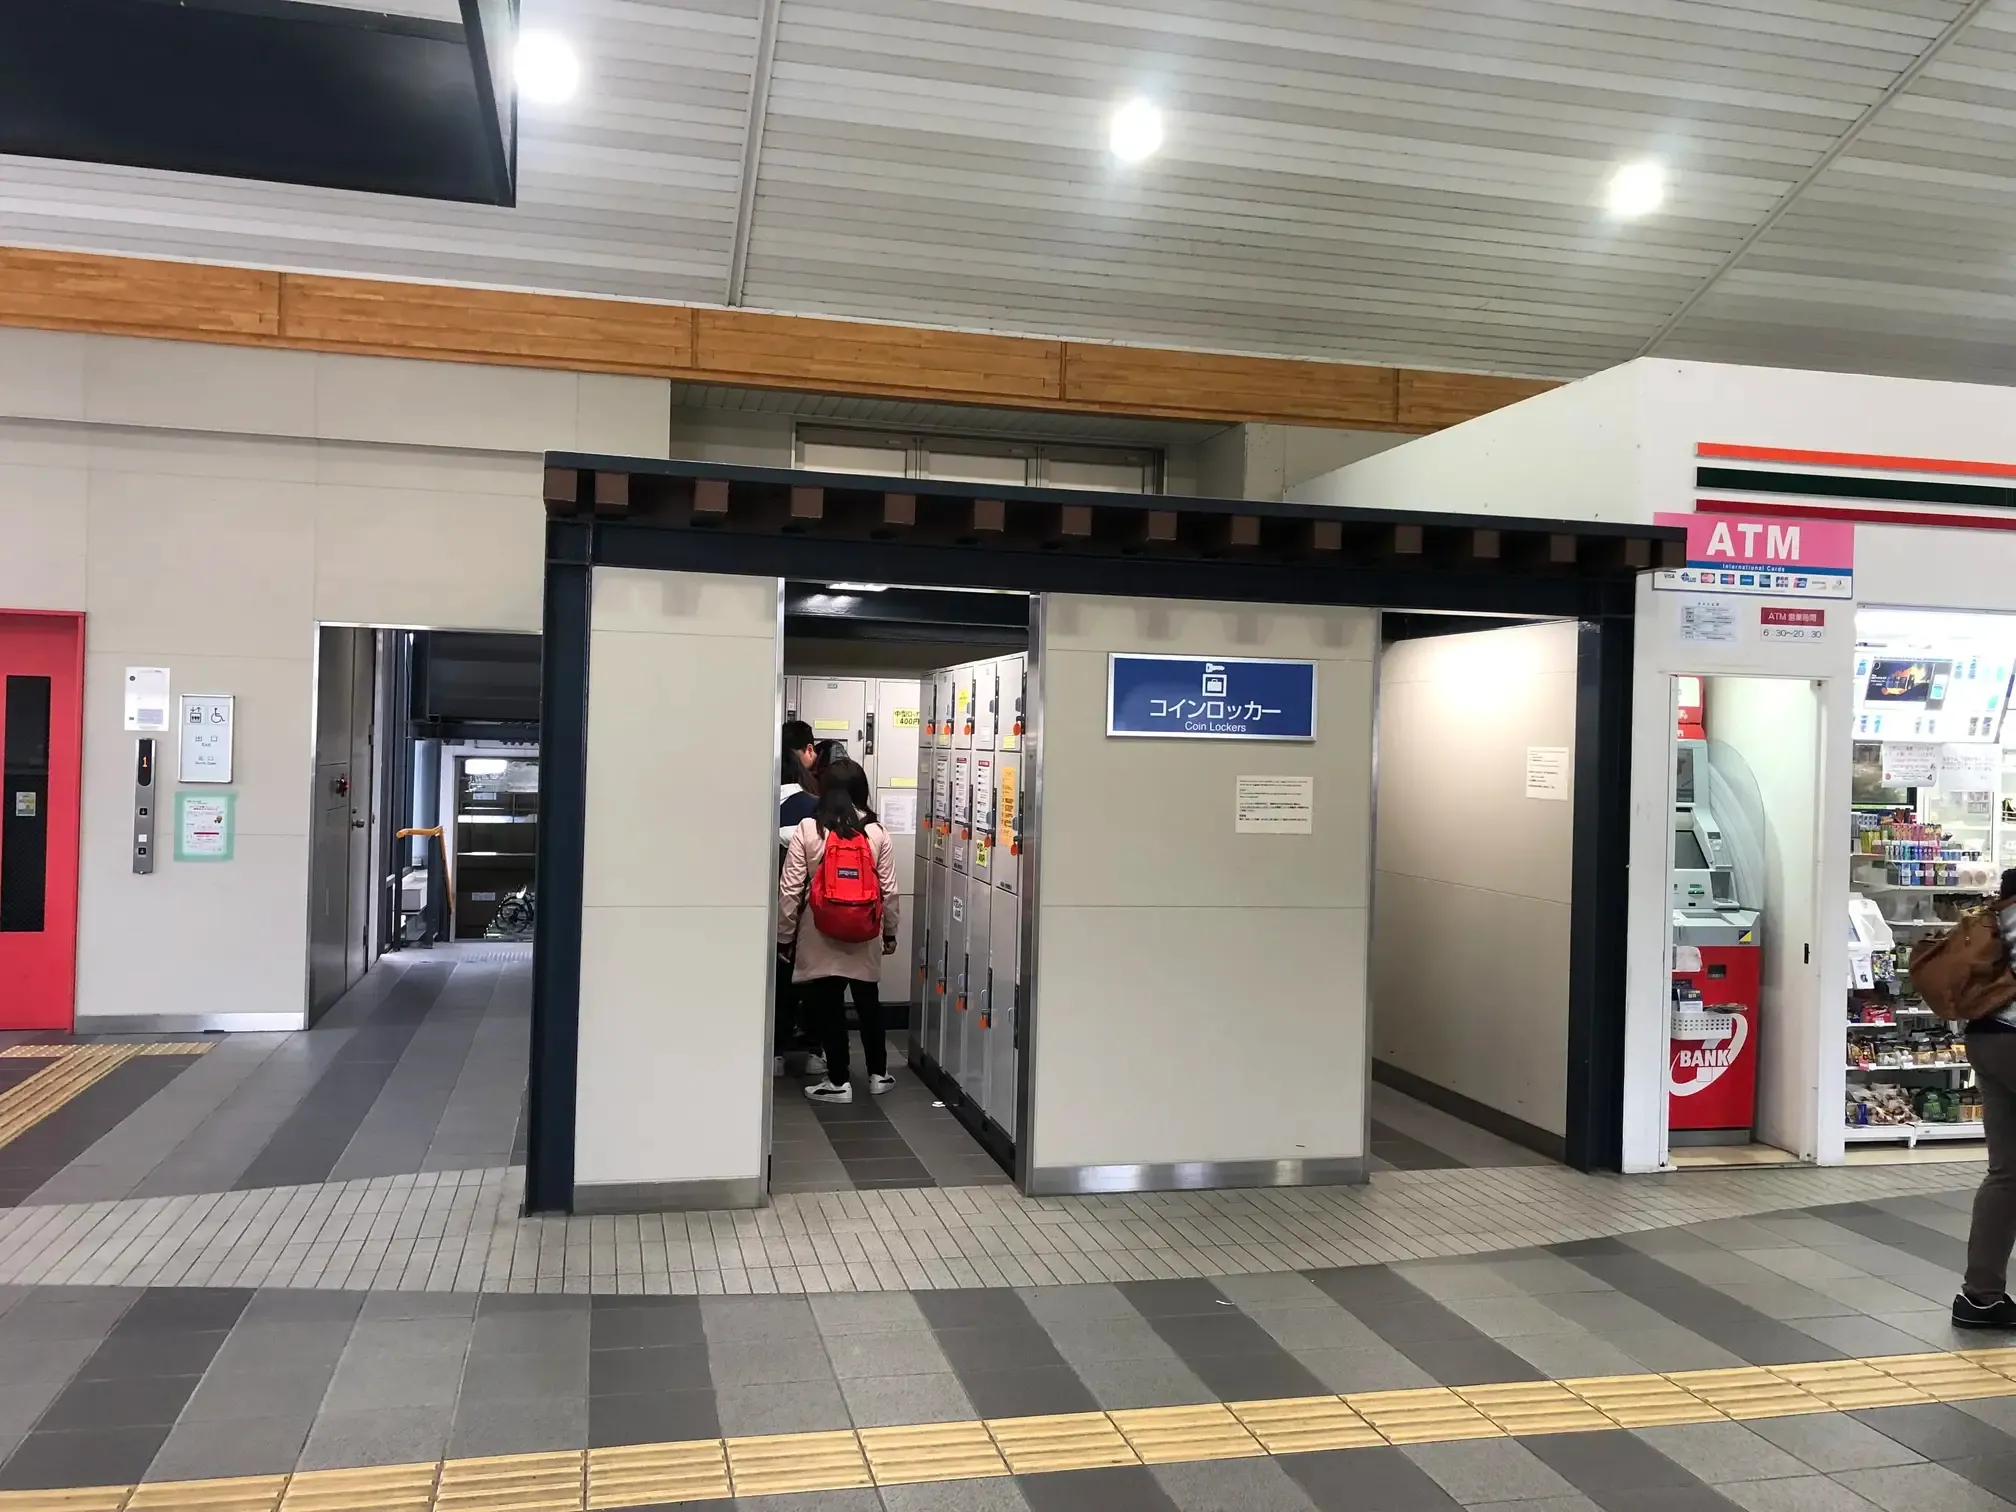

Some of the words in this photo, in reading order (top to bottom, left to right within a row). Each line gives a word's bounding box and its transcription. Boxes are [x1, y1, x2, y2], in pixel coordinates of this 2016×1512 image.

[1705, 521, 1801, 561] ATM
[1722, 563, 1765, 572] International
[1767, 565, 1786, 573] Cards
[1768, 612, 1787, 621] ATM
[1150, 699, 1281, 721] コインロッカー
[1184, 721, 1207, 731] Coin
[1209, 722, 1247, 733] Lockers
[142, 756, 148, 768] 1
[1680, 1050, 1730, 1067] BANK
